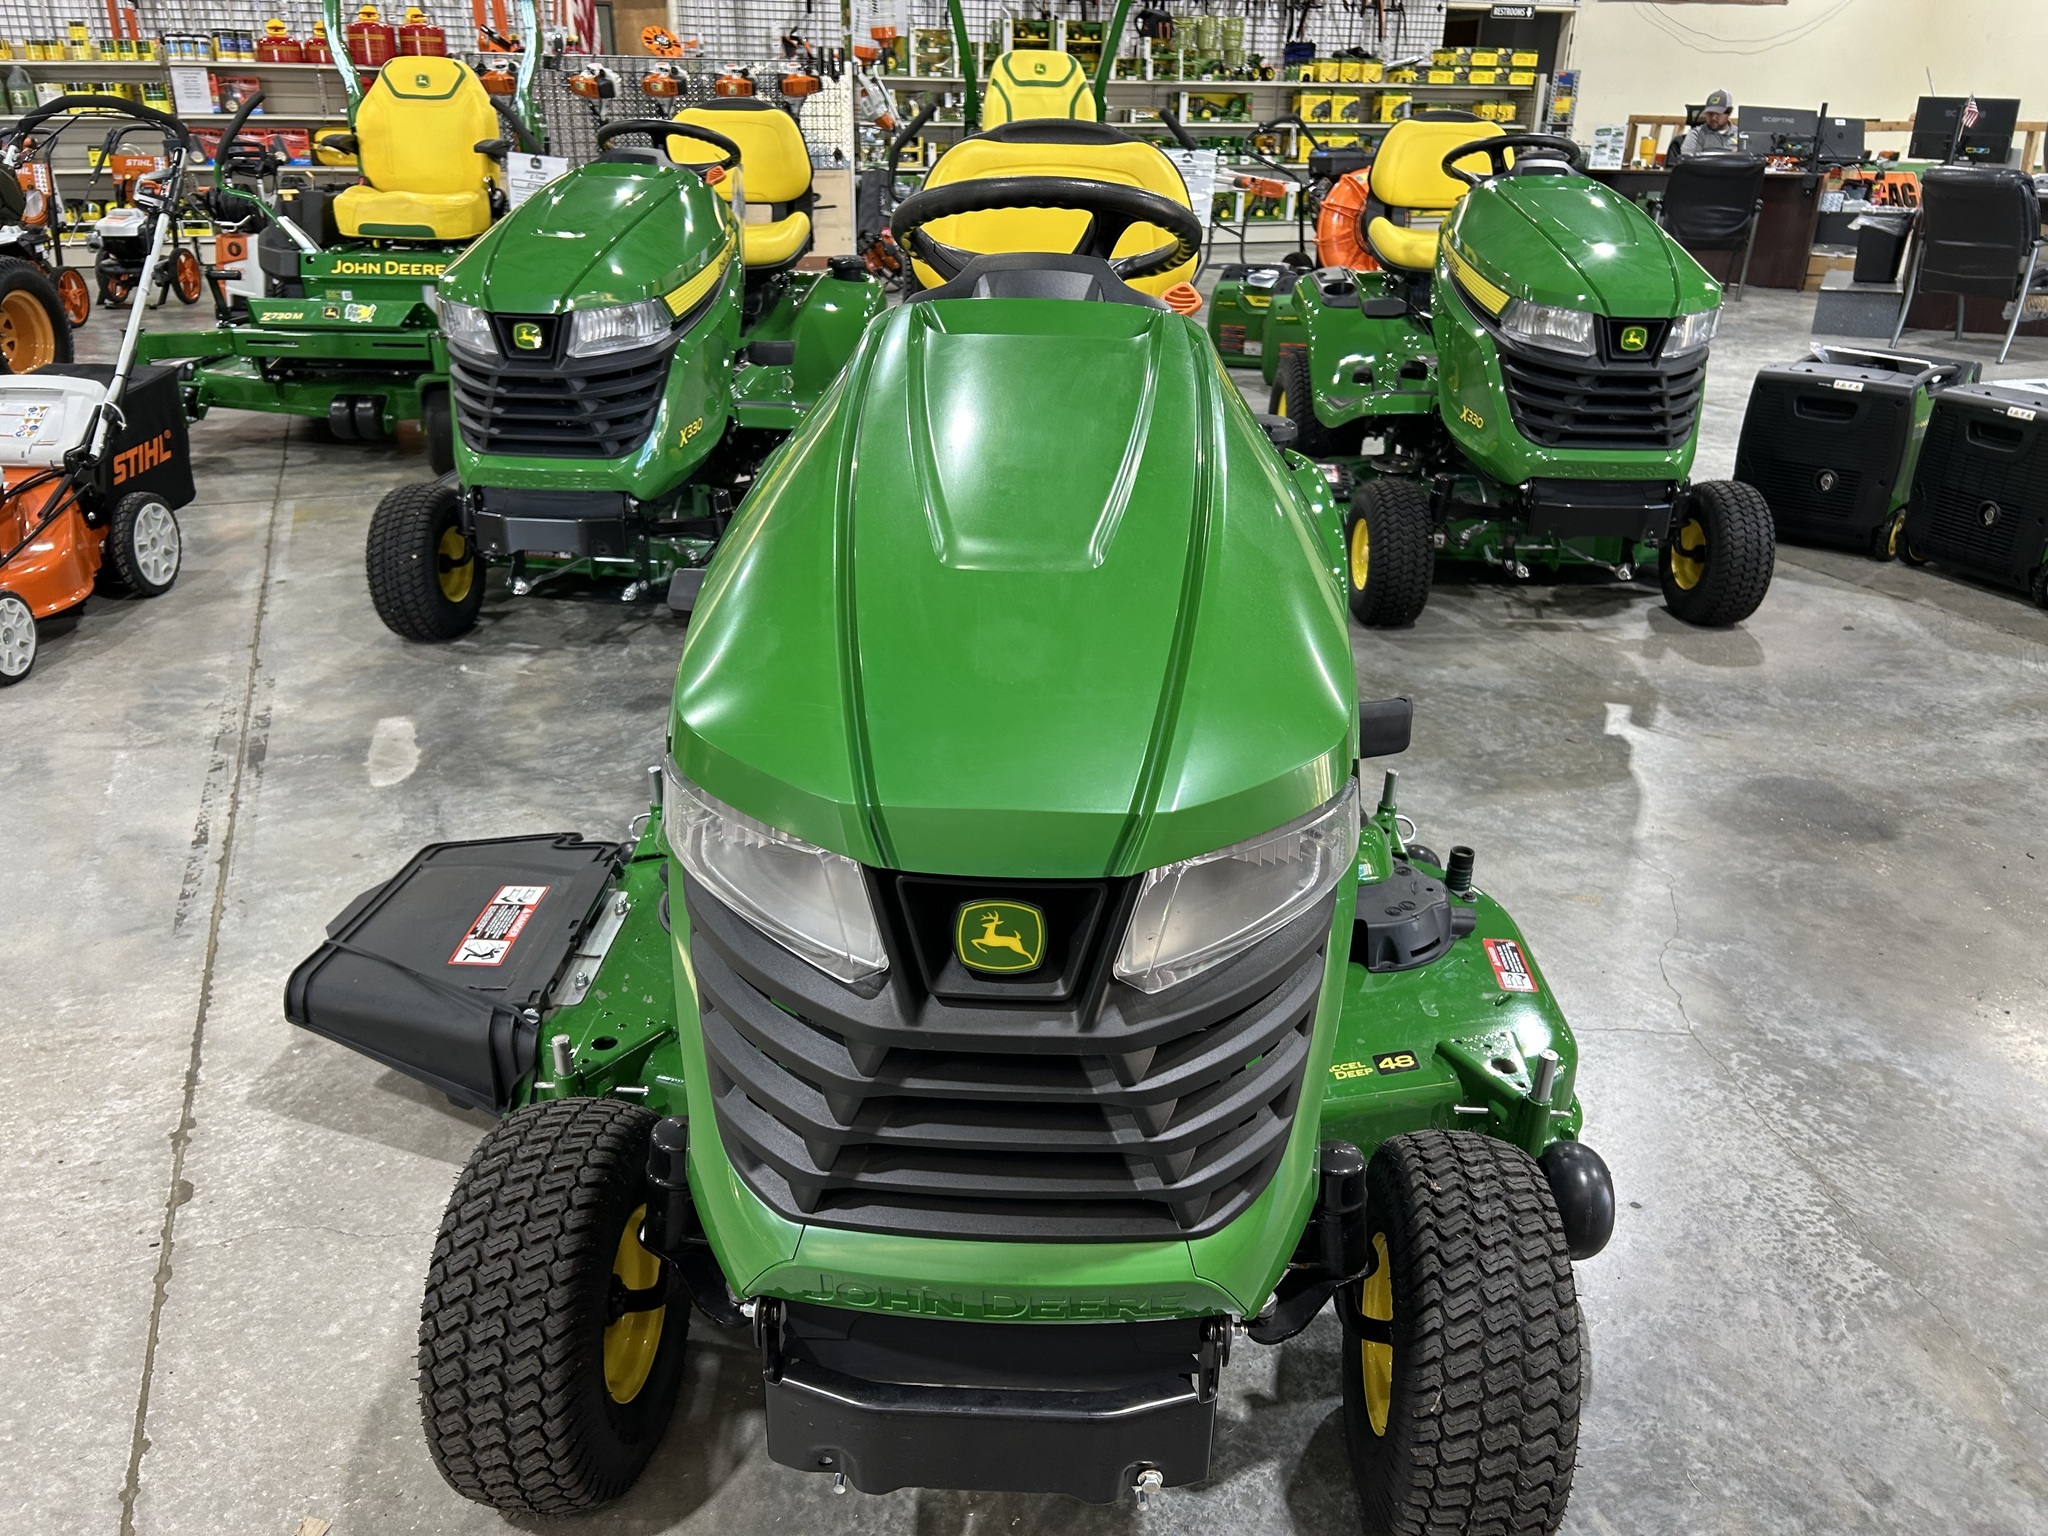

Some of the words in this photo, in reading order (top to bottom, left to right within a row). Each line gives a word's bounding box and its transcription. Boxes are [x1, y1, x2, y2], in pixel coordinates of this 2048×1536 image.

[1494, 7, 1526, 17] RESTROOMS
[126, 159, 152, 167] STIHL
[331, 259, 381, 275] JOHN
[385, 260, 446, 276] DEERE
[1460, 405, 1484, 429] X330
[679, 417, 703, 448] X330
[113, 434, 172, 486] STIHL
[1329, 1061, 1366, 1072] CCEL
[1335, 1067, 1373, 1080] DEEP
[1379, 1054, 1415, 1069] 48
[805, 1274, 965, 1316] JOHN
[983, 1289, 1189, 1319] DEERE
